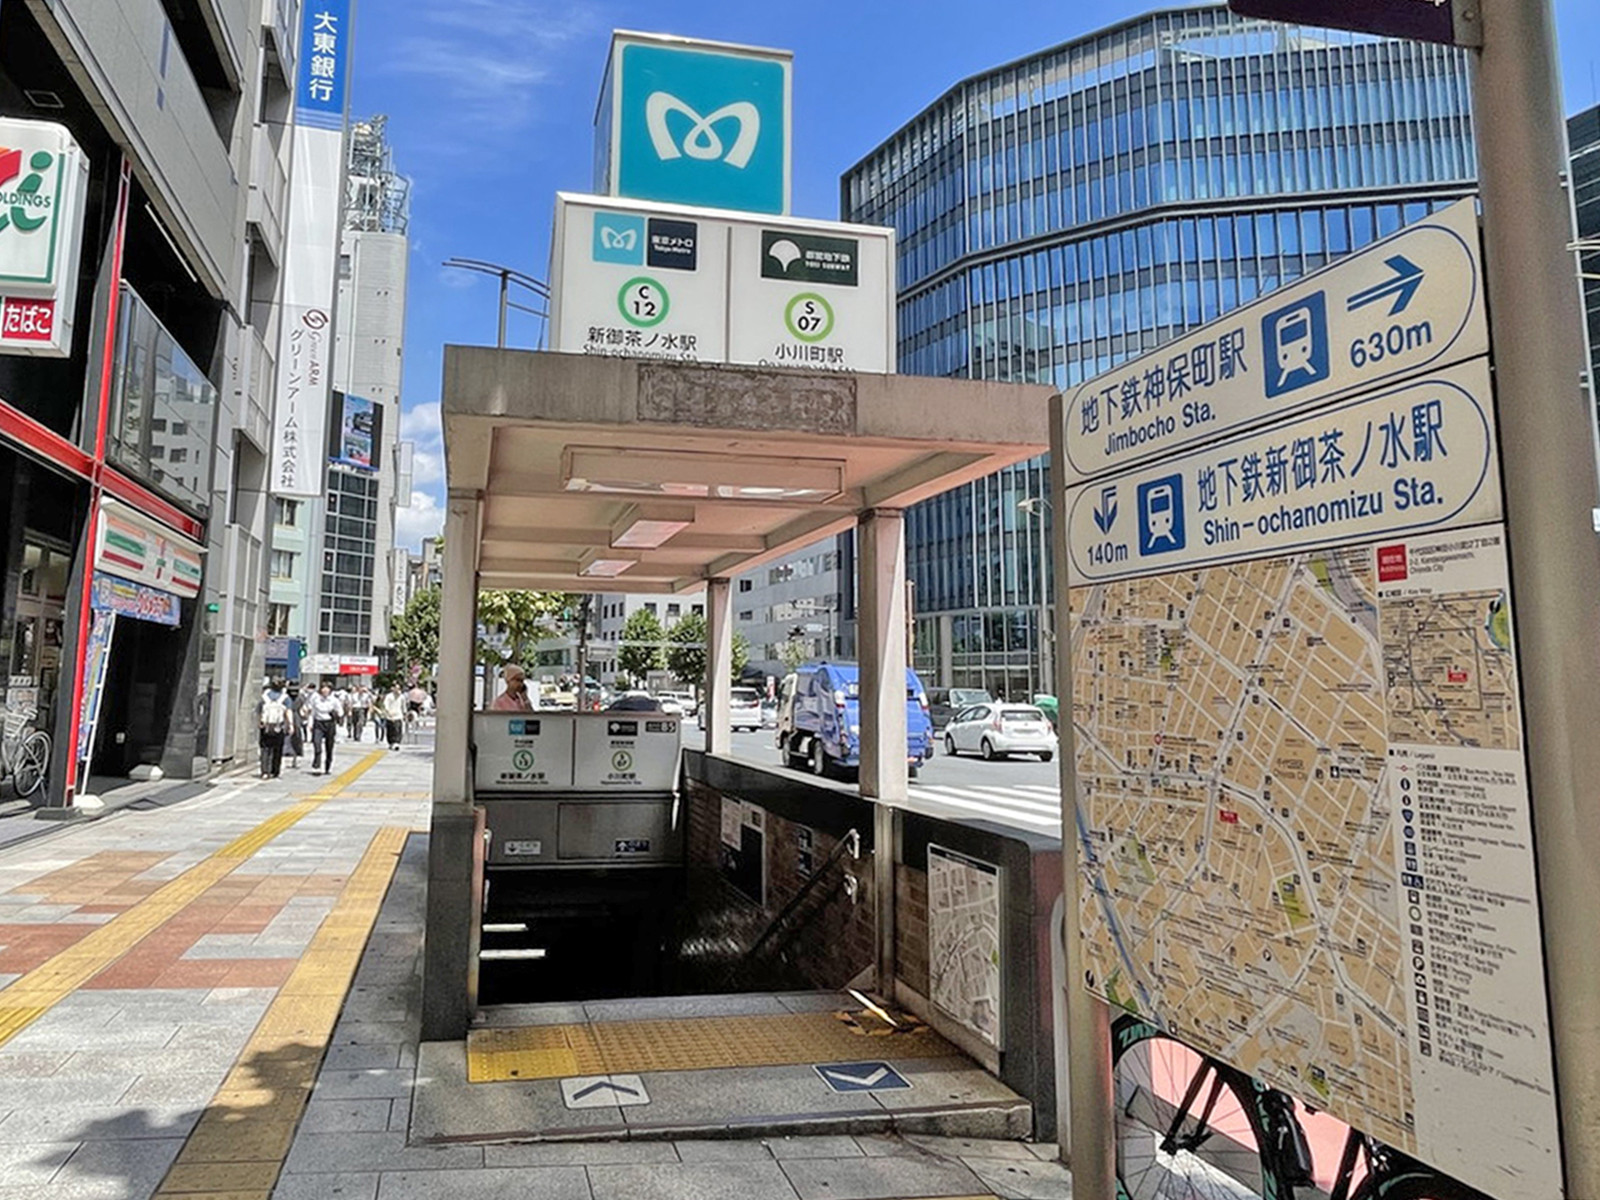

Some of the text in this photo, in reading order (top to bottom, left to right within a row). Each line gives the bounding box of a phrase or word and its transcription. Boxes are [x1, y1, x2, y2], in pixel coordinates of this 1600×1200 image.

[309, 11, 338, 101] 大東銀行
[638, 285, 650, 299] C
[4, 304, 51, 333] たばこ
[633, 300, 656, 317] 12
[805, 301, 815, 315] S
[797, 316, 821, 331] 07
[587, 326, 698, 351] 新御茶ノ水駅
[775, 343, 843, 363] 小川町駅
[1350, 319, 1433, 368] 630m
[1081, 327, 1248, 436] 地下鉄神保町駅
[281, 329, 304, 488] グリーンアーム株式会社
[1104, 402, 1216, 456] Jimbocho Sta.
[1197, 400, 1447, 513] 地下鉄新御茶ノ水駅
[1204, 478, 1444, 546] Shin-ochanomizu Sta.
[1087, 541, 1128, 566] 140m
